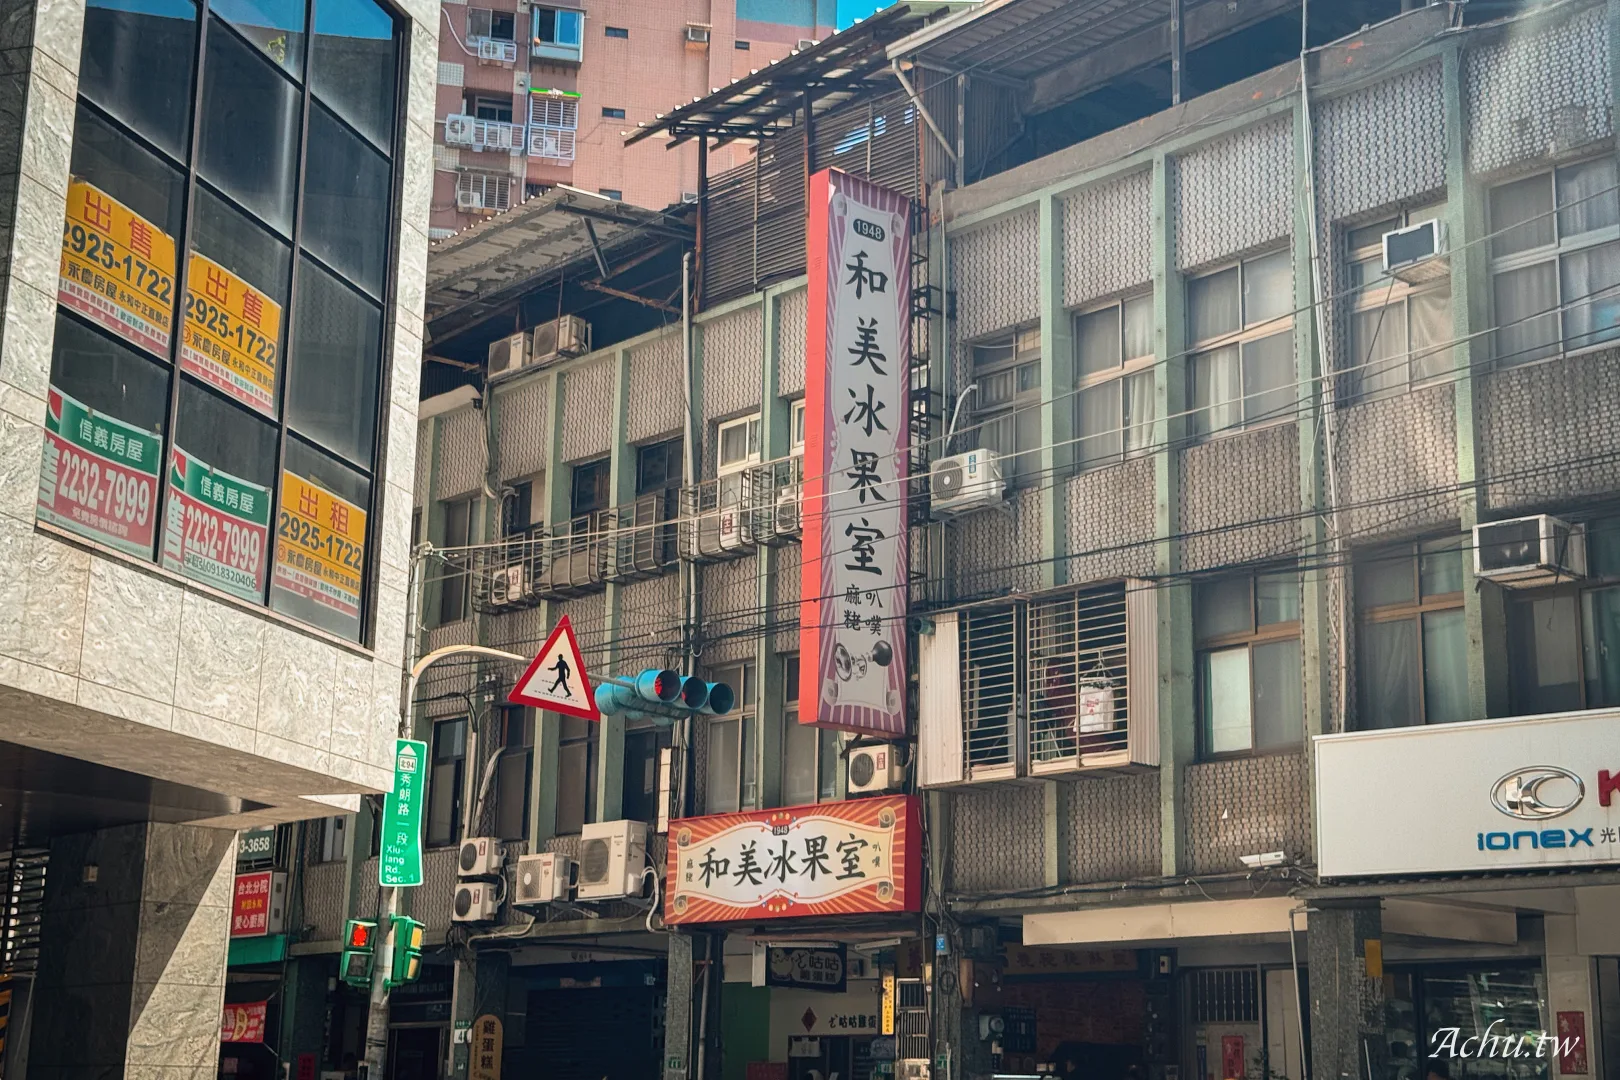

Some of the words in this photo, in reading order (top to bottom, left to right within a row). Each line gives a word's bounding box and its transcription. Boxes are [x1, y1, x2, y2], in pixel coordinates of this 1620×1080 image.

[84, 190, 153, 261] 出售
[856, 219, 883, 240] 1948
[63, 220, 172, 305] 2925-1722
[67, 260, 117, 300] 永慶房屋
[206, 266, 264, 329] 出售
[185, 292, 276, 369] 2925-1722
[844, 250, 888, 576] 和美冰果室
[79, 418, 143, 462] 信義房屋
[59, 449, 150, 526] 2232-7999
[201, 475, 254, 515] 信義房屋
[299, 485, 349, 535] 出租
[164, 490, 185, 559] 售
[185, 503, 260, 573] 2232-7999
[279, 511, 361, 572] 2925-1722
[865, 589, 884, 637] 叭噗
[396, 773, 412, 846] 秀朗路一段
[773, 825, 788, 836] 1948
[1600, 825, 1620, 844] 光
[385, 855, 405, 865] lang
[698, 833, 869, 889] 和美冰果室
[1477, 828, 1595, 851] ionex
[385, 864, 401, 873] Rd.
[385, 873, 406, 882] Sec.
[409, 873, 414, 882] 1
[480, 1020, 496, 1070] 雞蛋糕
